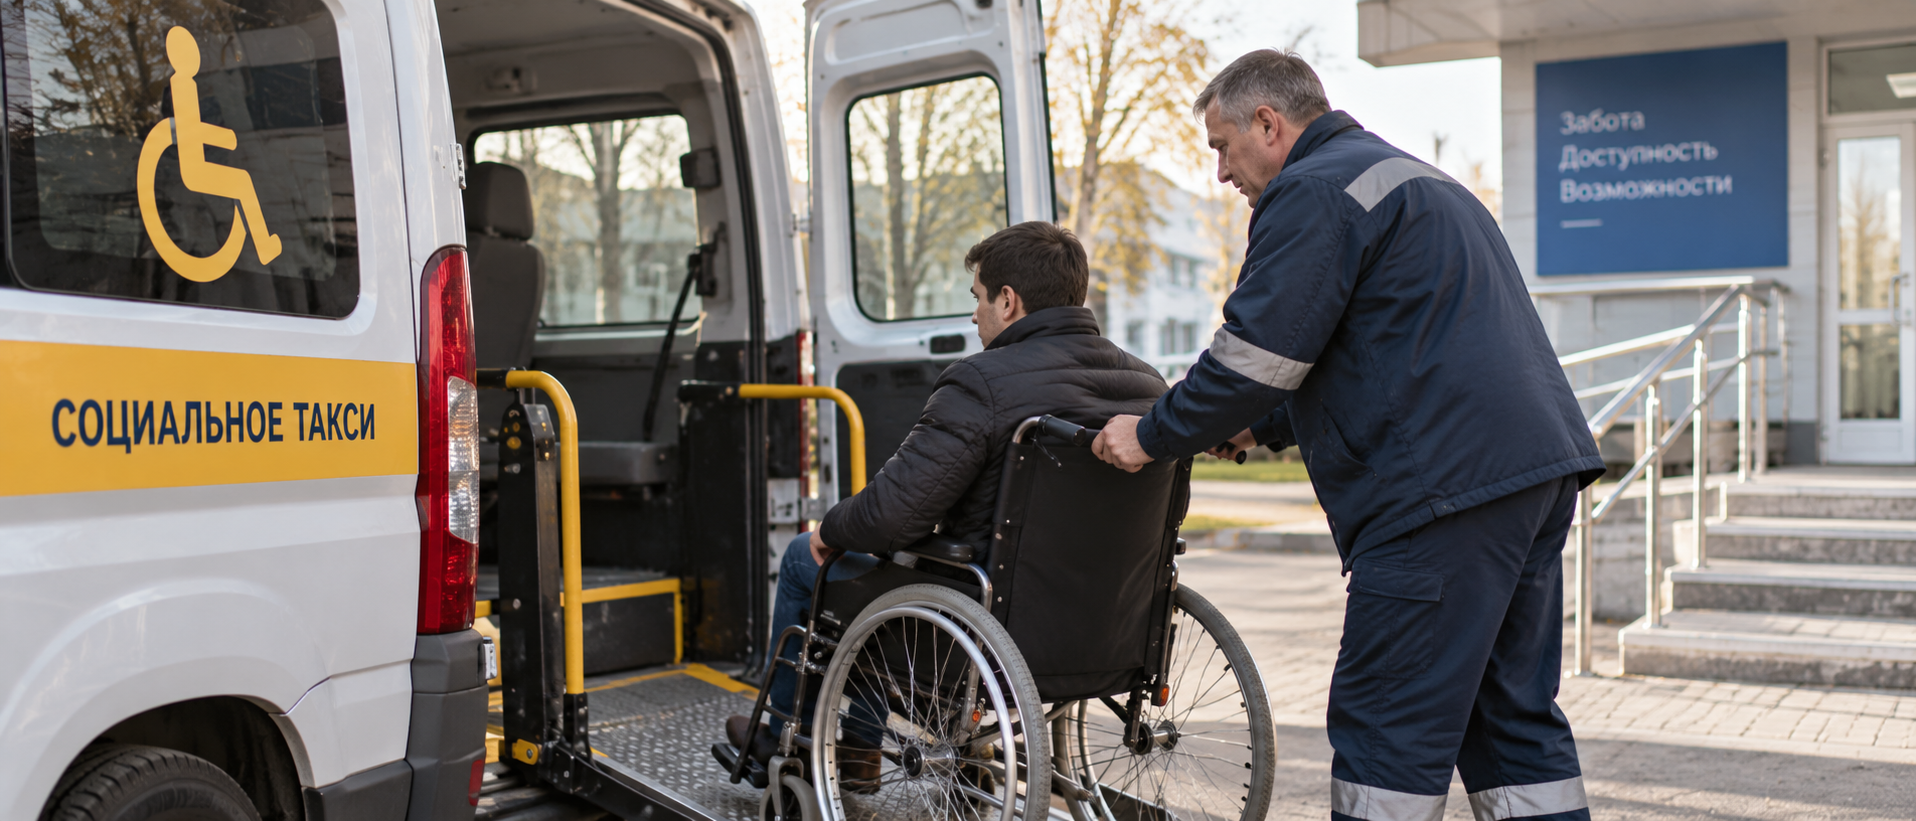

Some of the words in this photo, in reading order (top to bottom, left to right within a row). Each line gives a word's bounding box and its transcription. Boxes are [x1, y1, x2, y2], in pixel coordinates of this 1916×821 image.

[1560, 109, 1645, 135] Забота
[1559, 142, 1719, 172] Доступность
[1560, 175, 1733, 203] Возможности
[52, 399, 284, 454] СОЦИАЛЬНОЕ
[293, 403, 376, 441] ТАКСИ
